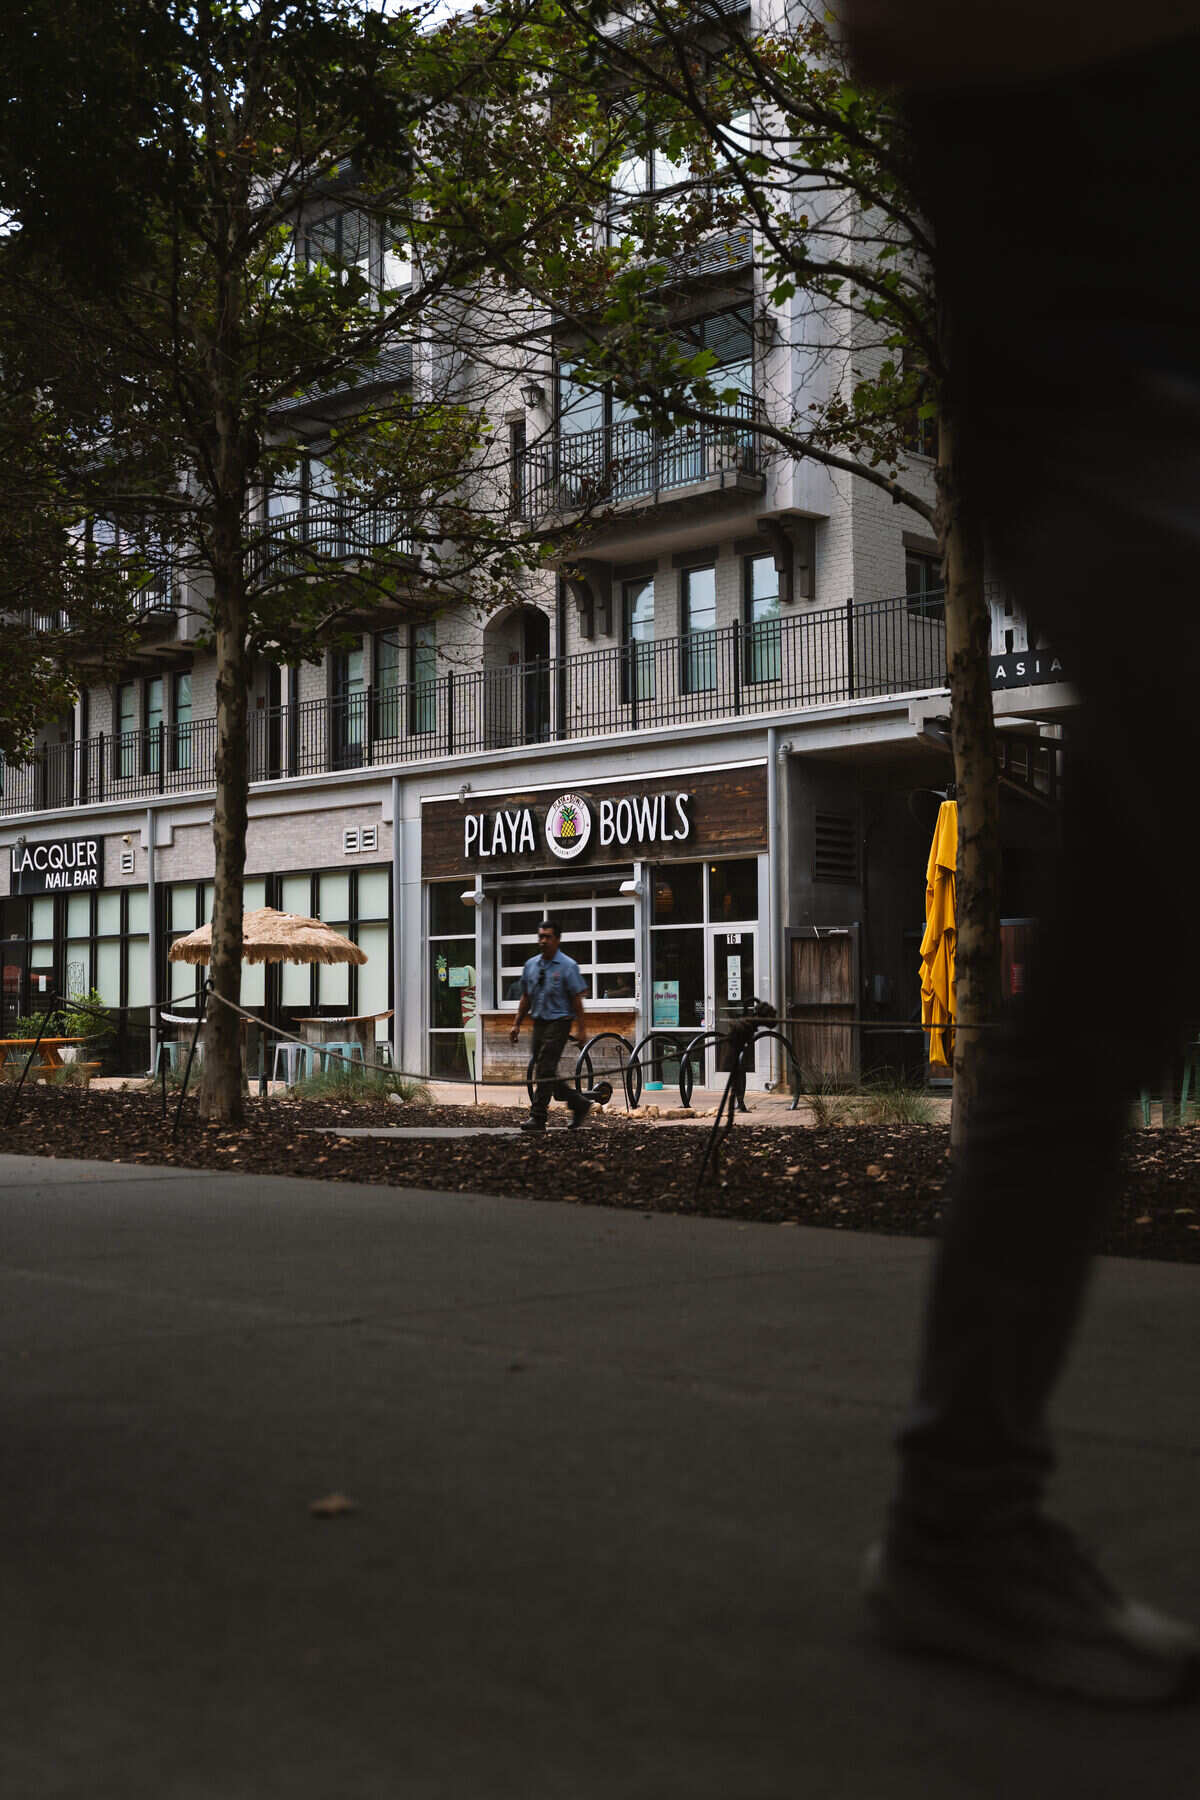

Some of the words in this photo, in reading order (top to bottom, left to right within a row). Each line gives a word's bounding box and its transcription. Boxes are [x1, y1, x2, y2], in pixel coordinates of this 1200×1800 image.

[464, 808, 535, 858] PLAYA
[600, 793, 689, 845] BOWLS
[12, 841, 97, 873] LACQUER
[45, 871, 72, 889] NAIL
[74, 869, 97, 887] BAR
